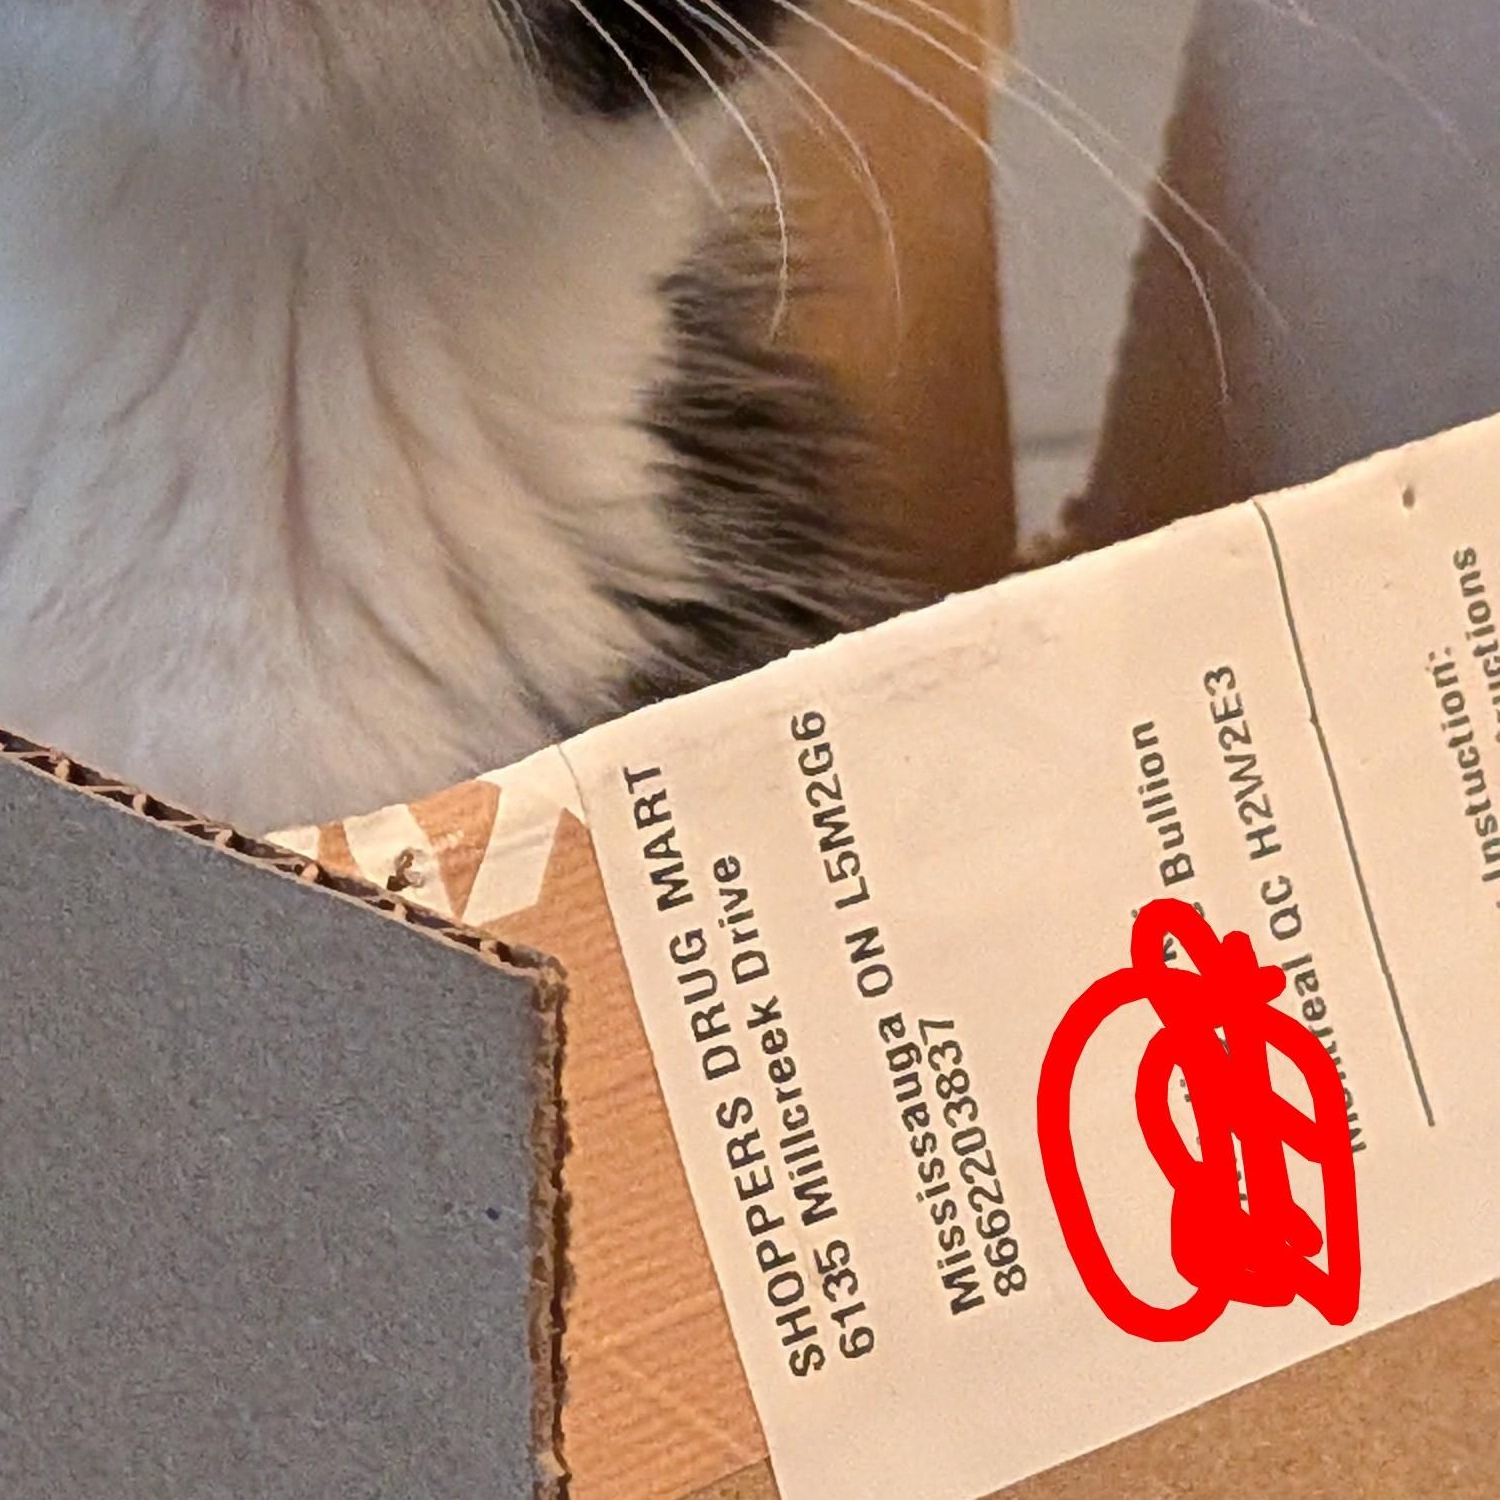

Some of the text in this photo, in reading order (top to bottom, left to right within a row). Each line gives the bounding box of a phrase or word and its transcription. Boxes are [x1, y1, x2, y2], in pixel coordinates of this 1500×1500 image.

[1132, 721, 1195, 887] Bullion
[1203, 666, 1282, 860] H2W2E3
[790, 711, 986, 1316] Mississauga ON L5M2G6
[1261, 875, 1302, 941] QC
[623, 766, 825, 1377] SHOPPERS DRUG MART
[713, 855, 875, 1359] 6135 Millcreek Drive
[918, 1019, 1027, 1297] 8662203837
